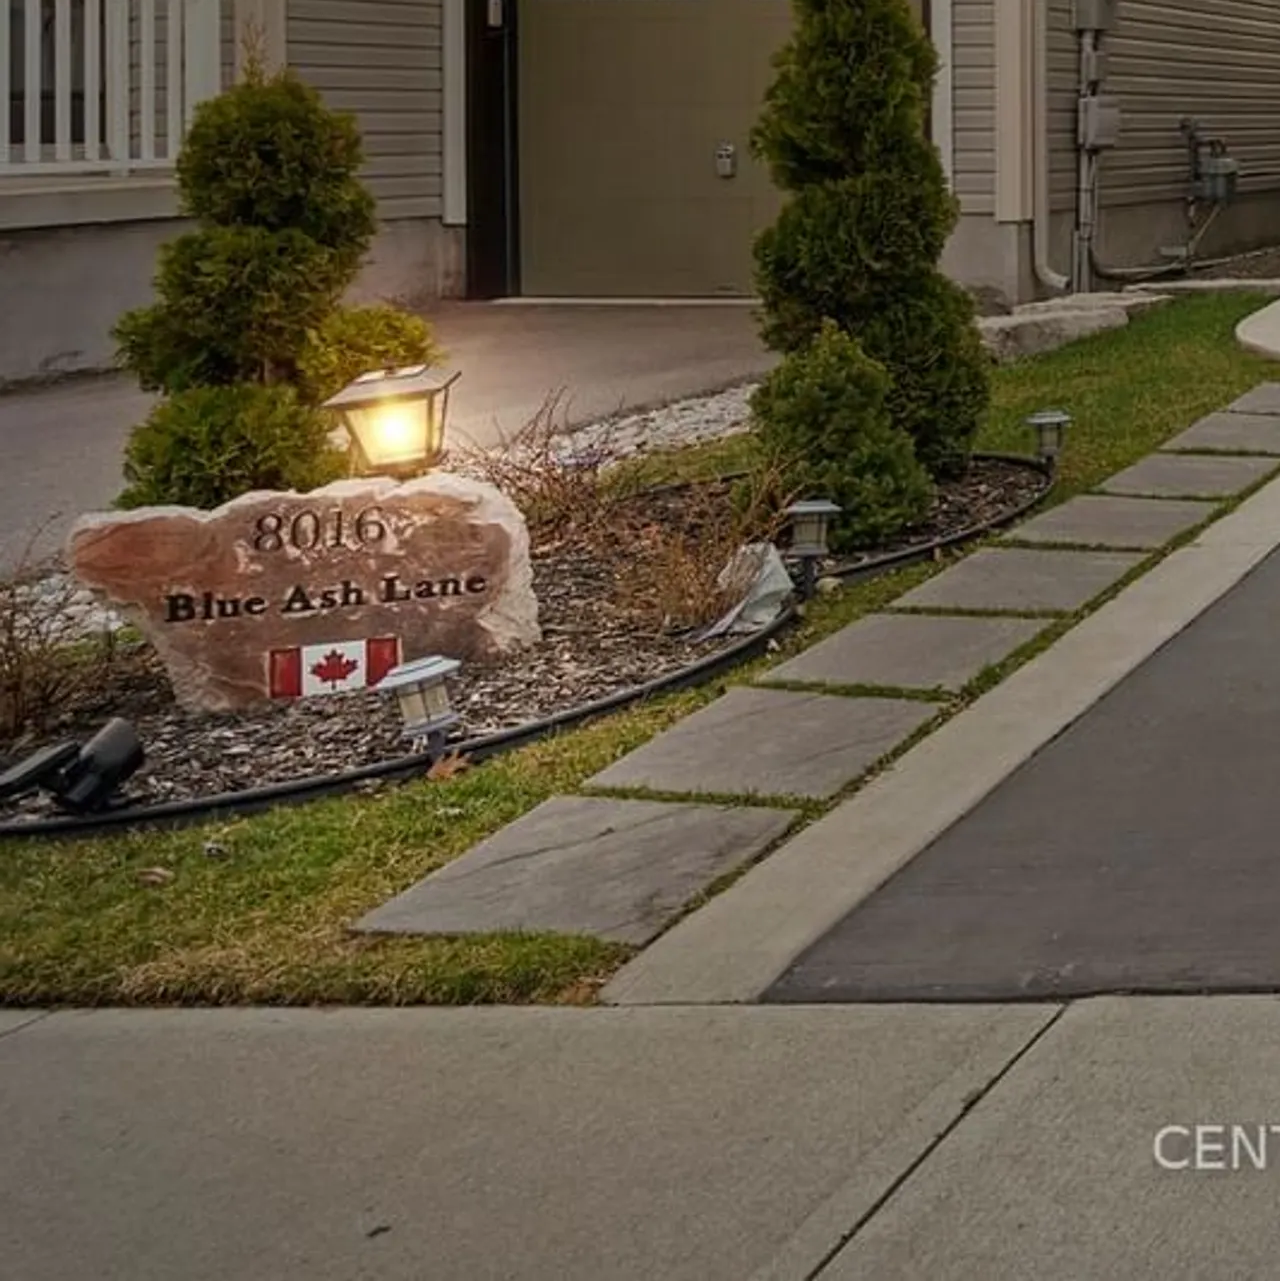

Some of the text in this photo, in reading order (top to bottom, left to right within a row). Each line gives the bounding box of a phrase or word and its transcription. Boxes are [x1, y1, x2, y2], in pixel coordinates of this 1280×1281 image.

[254, 506, 386, 552] 8016
[164, 575, 487, 623] Blue Ash Lane
